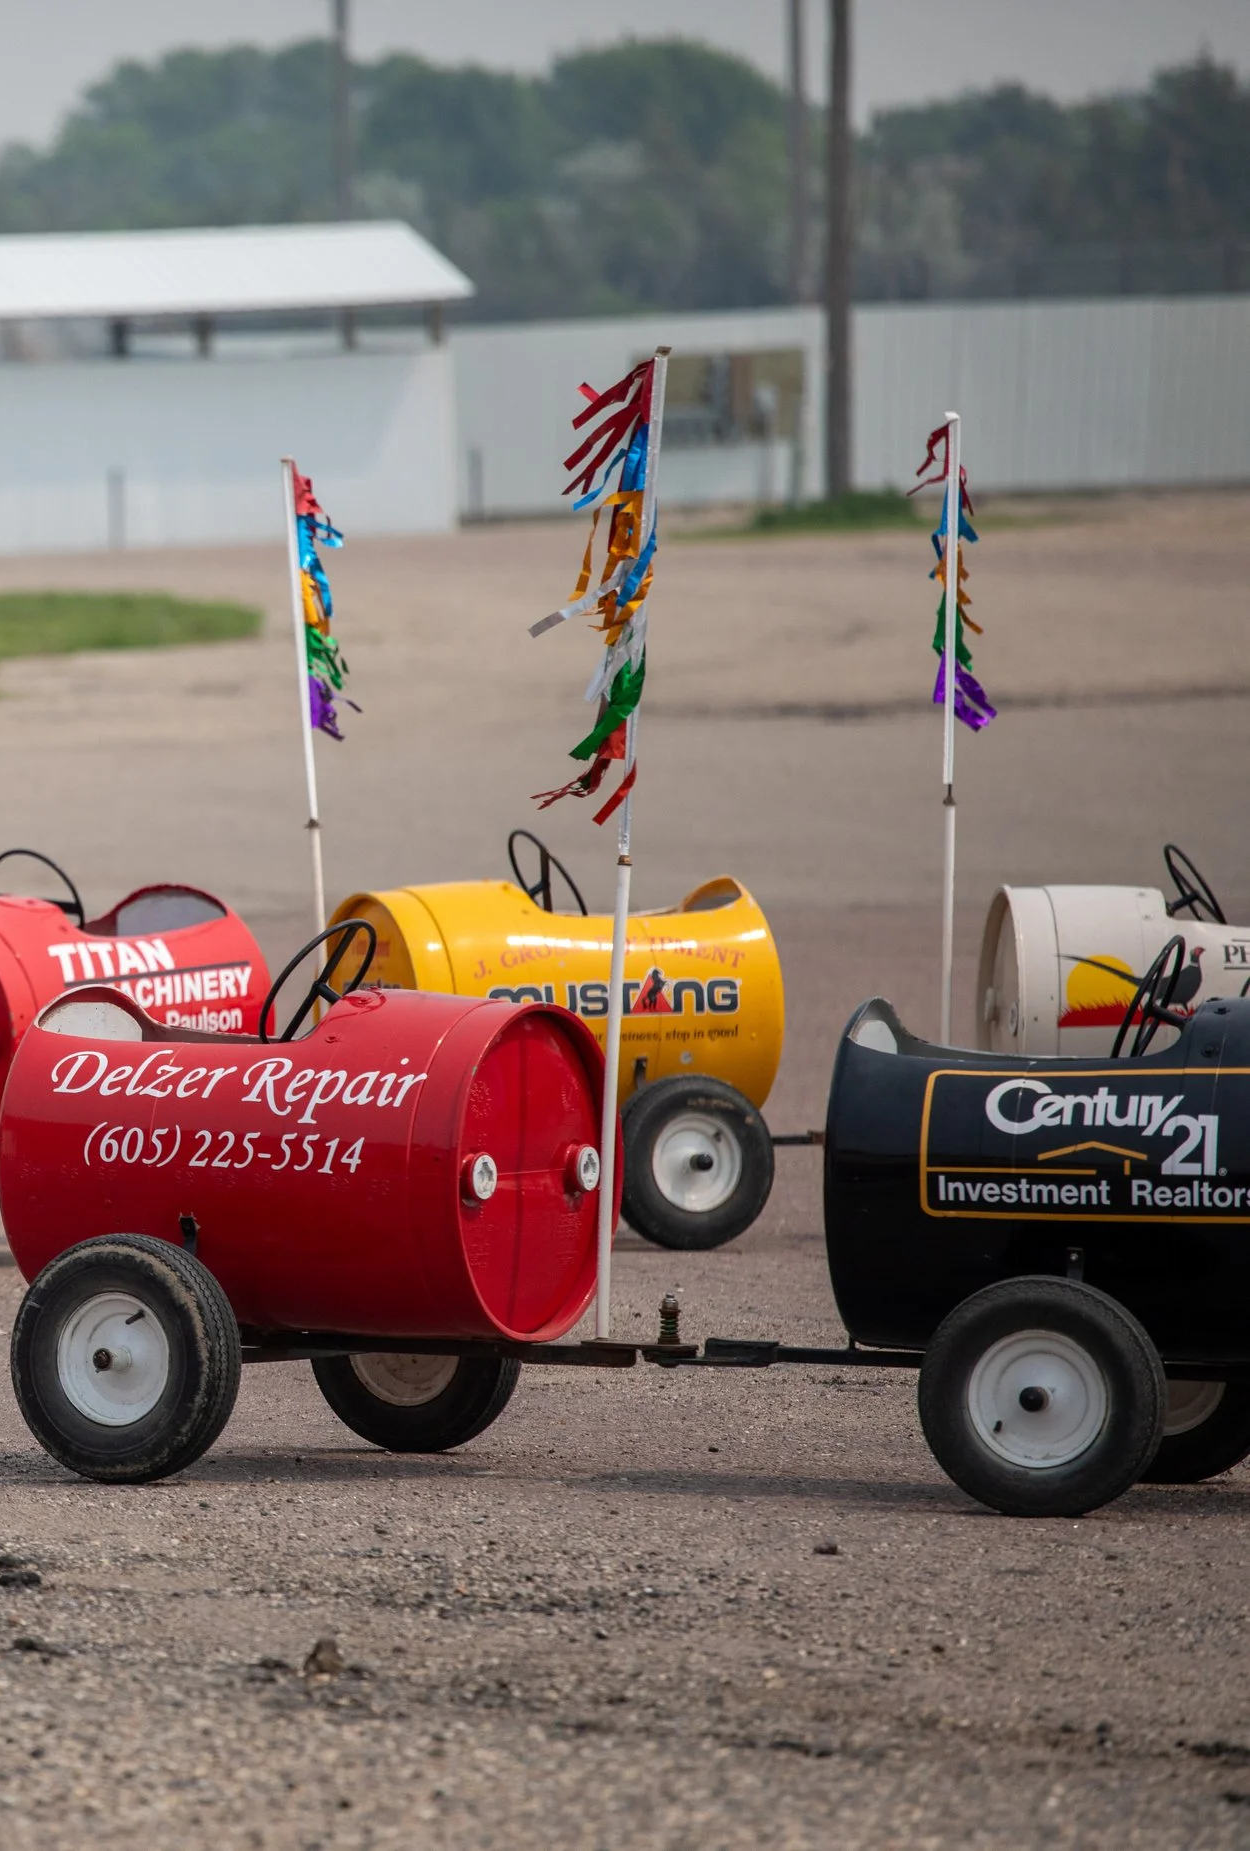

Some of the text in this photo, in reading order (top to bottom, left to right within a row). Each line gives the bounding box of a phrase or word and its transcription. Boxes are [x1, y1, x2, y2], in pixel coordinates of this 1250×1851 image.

[48, 939, 175, 983] TITAN
[107, 966, 251, 1009] ACHINERY
[165, 1006, 243, 1033] Paulson
[51, 1050, 238, 1098] Delzer
[241, 1057, 428, 1125] Repair
[84, 1122, 366, 1175] (605) 225-5514
[985, 1079, 1220, 1176] Century 21
[938, 1175, 1111, 1206] Investment
